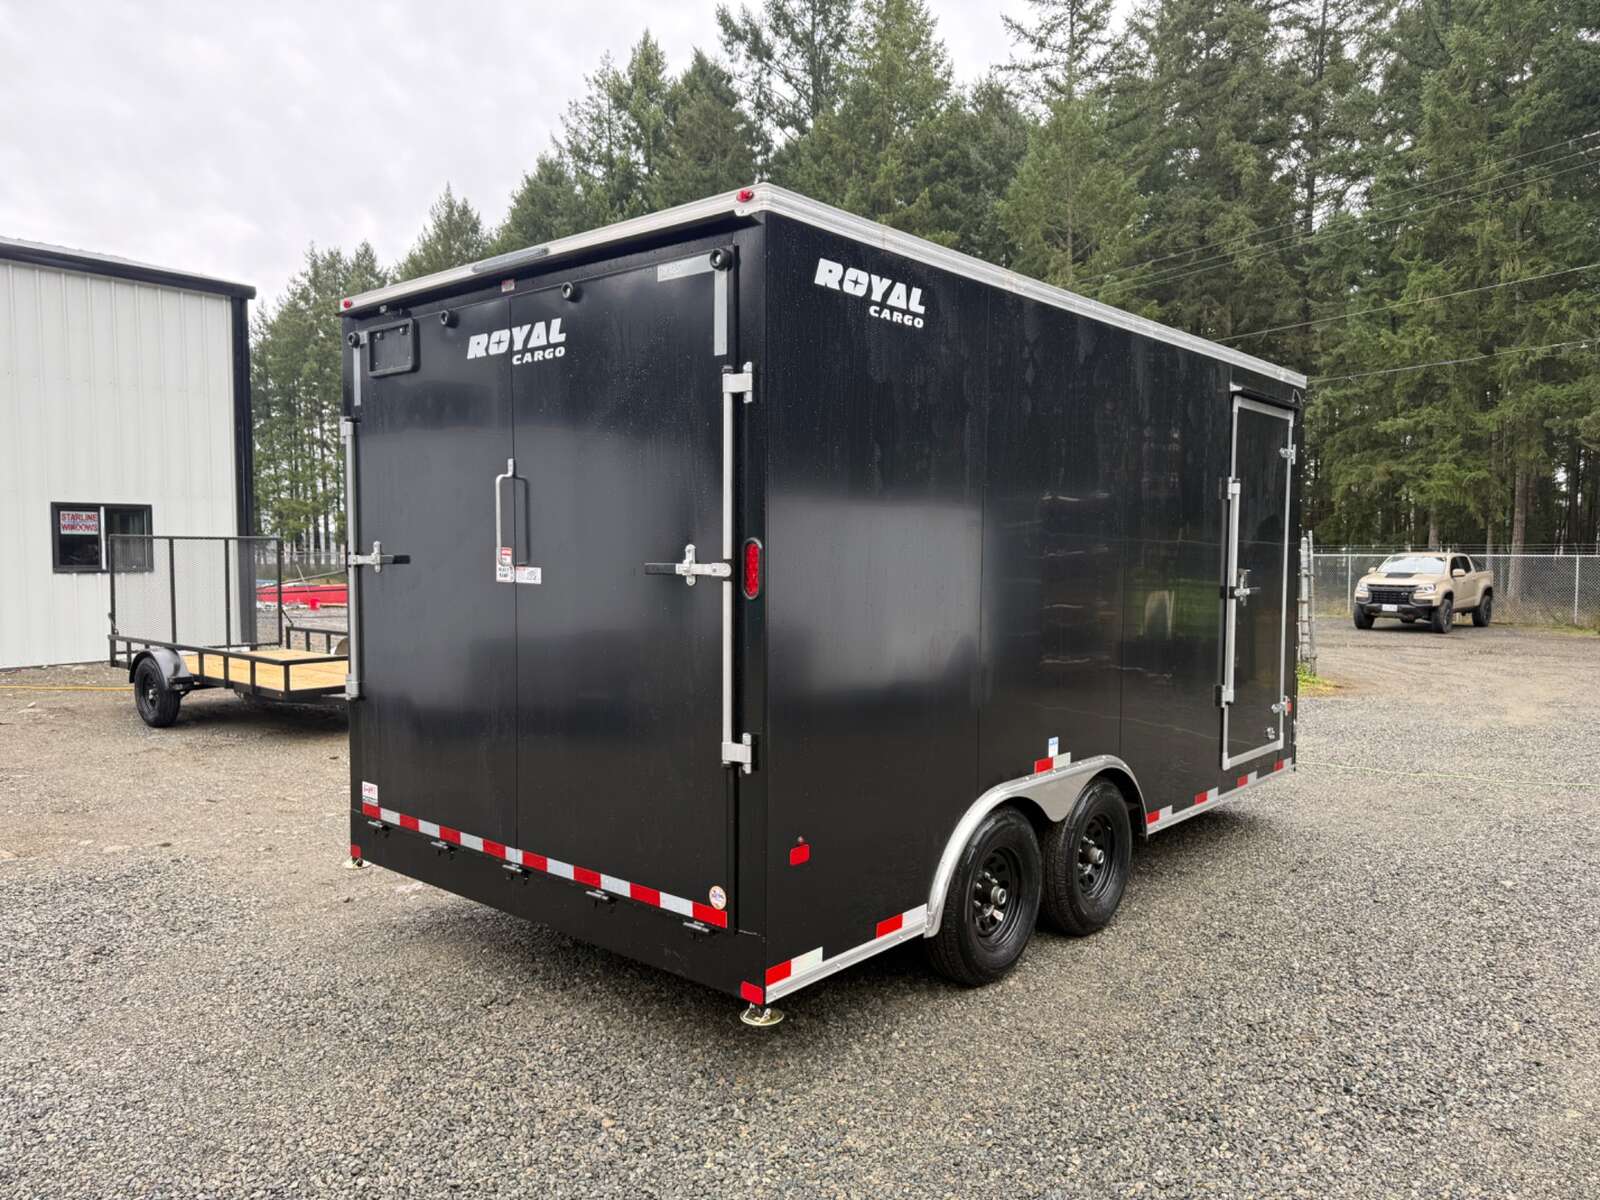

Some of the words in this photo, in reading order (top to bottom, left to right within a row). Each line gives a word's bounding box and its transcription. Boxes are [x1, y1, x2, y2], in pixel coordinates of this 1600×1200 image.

[814, 257, 925, 315] ROYAL
[868, 305, 924, 329] CARGO
[466, 317, 566, 360] ROYAL
[511, 346, 566, 365] CARGO
[62, 513, 97, 521] STARLINE
